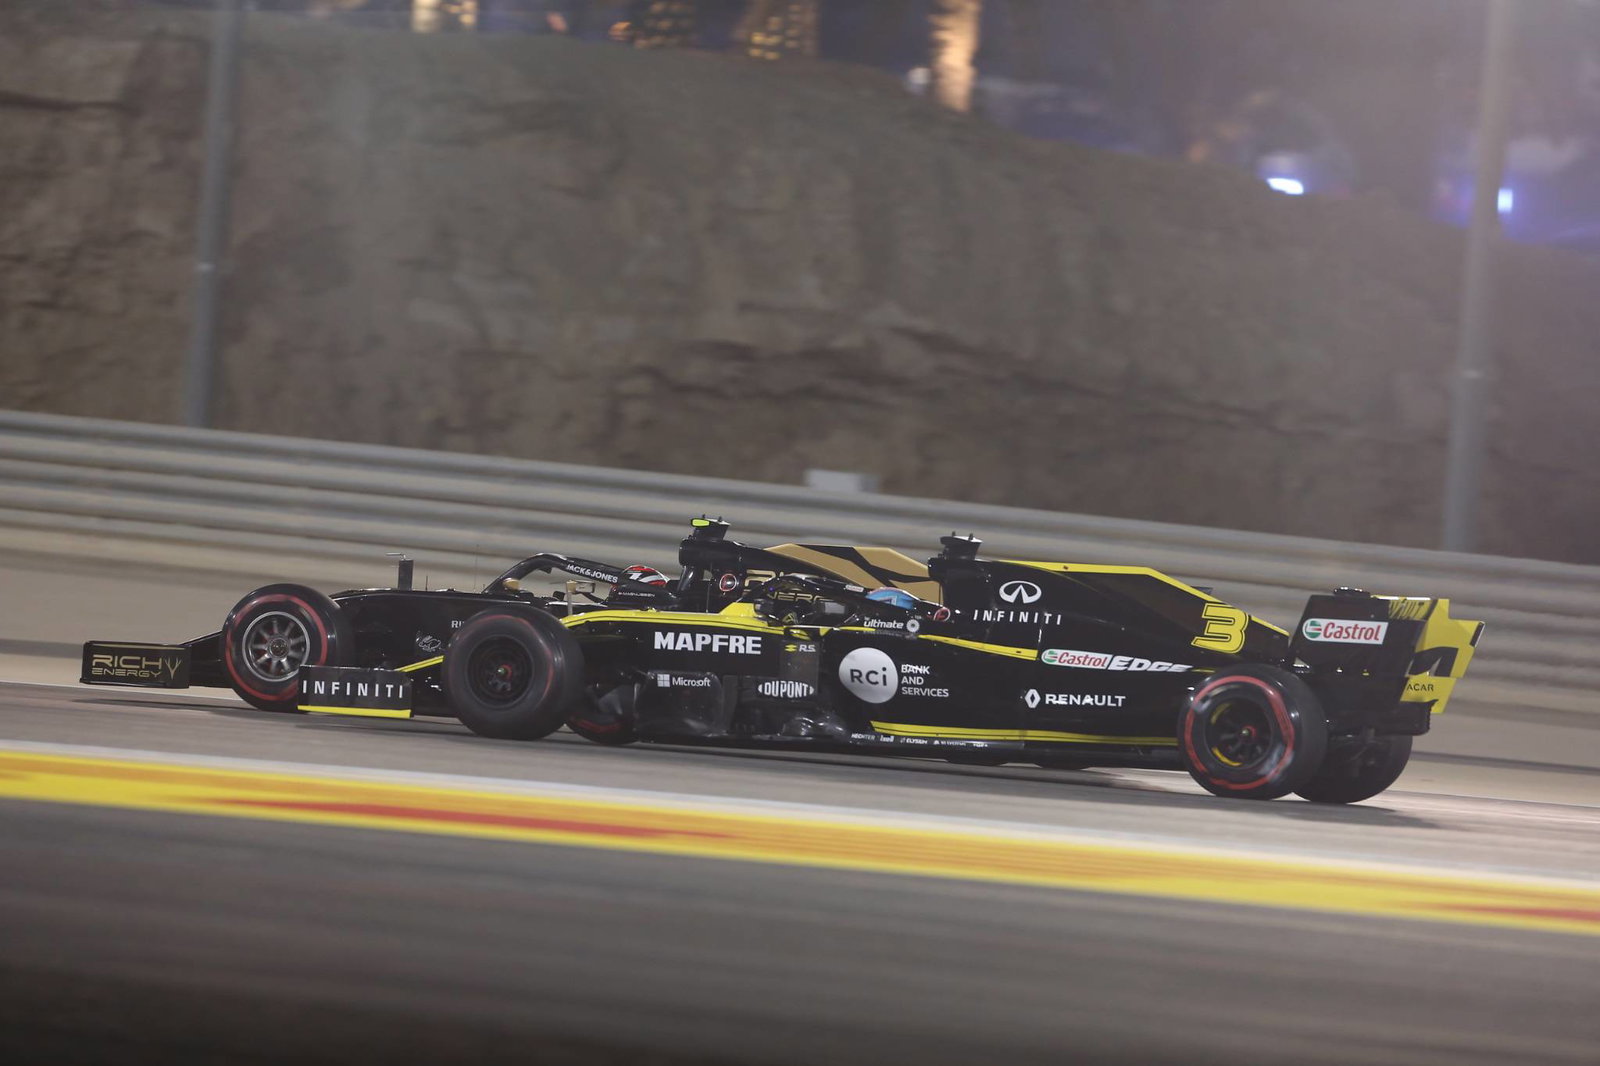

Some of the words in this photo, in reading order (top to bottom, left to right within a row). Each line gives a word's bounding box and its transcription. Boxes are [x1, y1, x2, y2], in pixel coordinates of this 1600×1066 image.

[973, 609, 1061, 625] INFINITI
[863, 619, 904, 629] ultimate
[1191, 603, 1249, 654] 3
[1323, 622, 1380, 641] Castrol
[654, 631, 762, 655] MAPFRE
[799, 644, 816, 652] RS
[92, 654, 162, 670] RICH
[1057, 651, 1108, 668] Castrol
[1107, 656, 1193, 673] EDGE
[91, 667, 162, 678] ENERGY
[901, 664, 931, 675] BANK
[672, 677, 711, 687] Microsoft
[901, 676, 925, 685] AND
[302, 680, 404, 699] INFINITI
[901, 687, 949, 698] SERVICES
[1045, 694, 1126, 707] RENAULT
